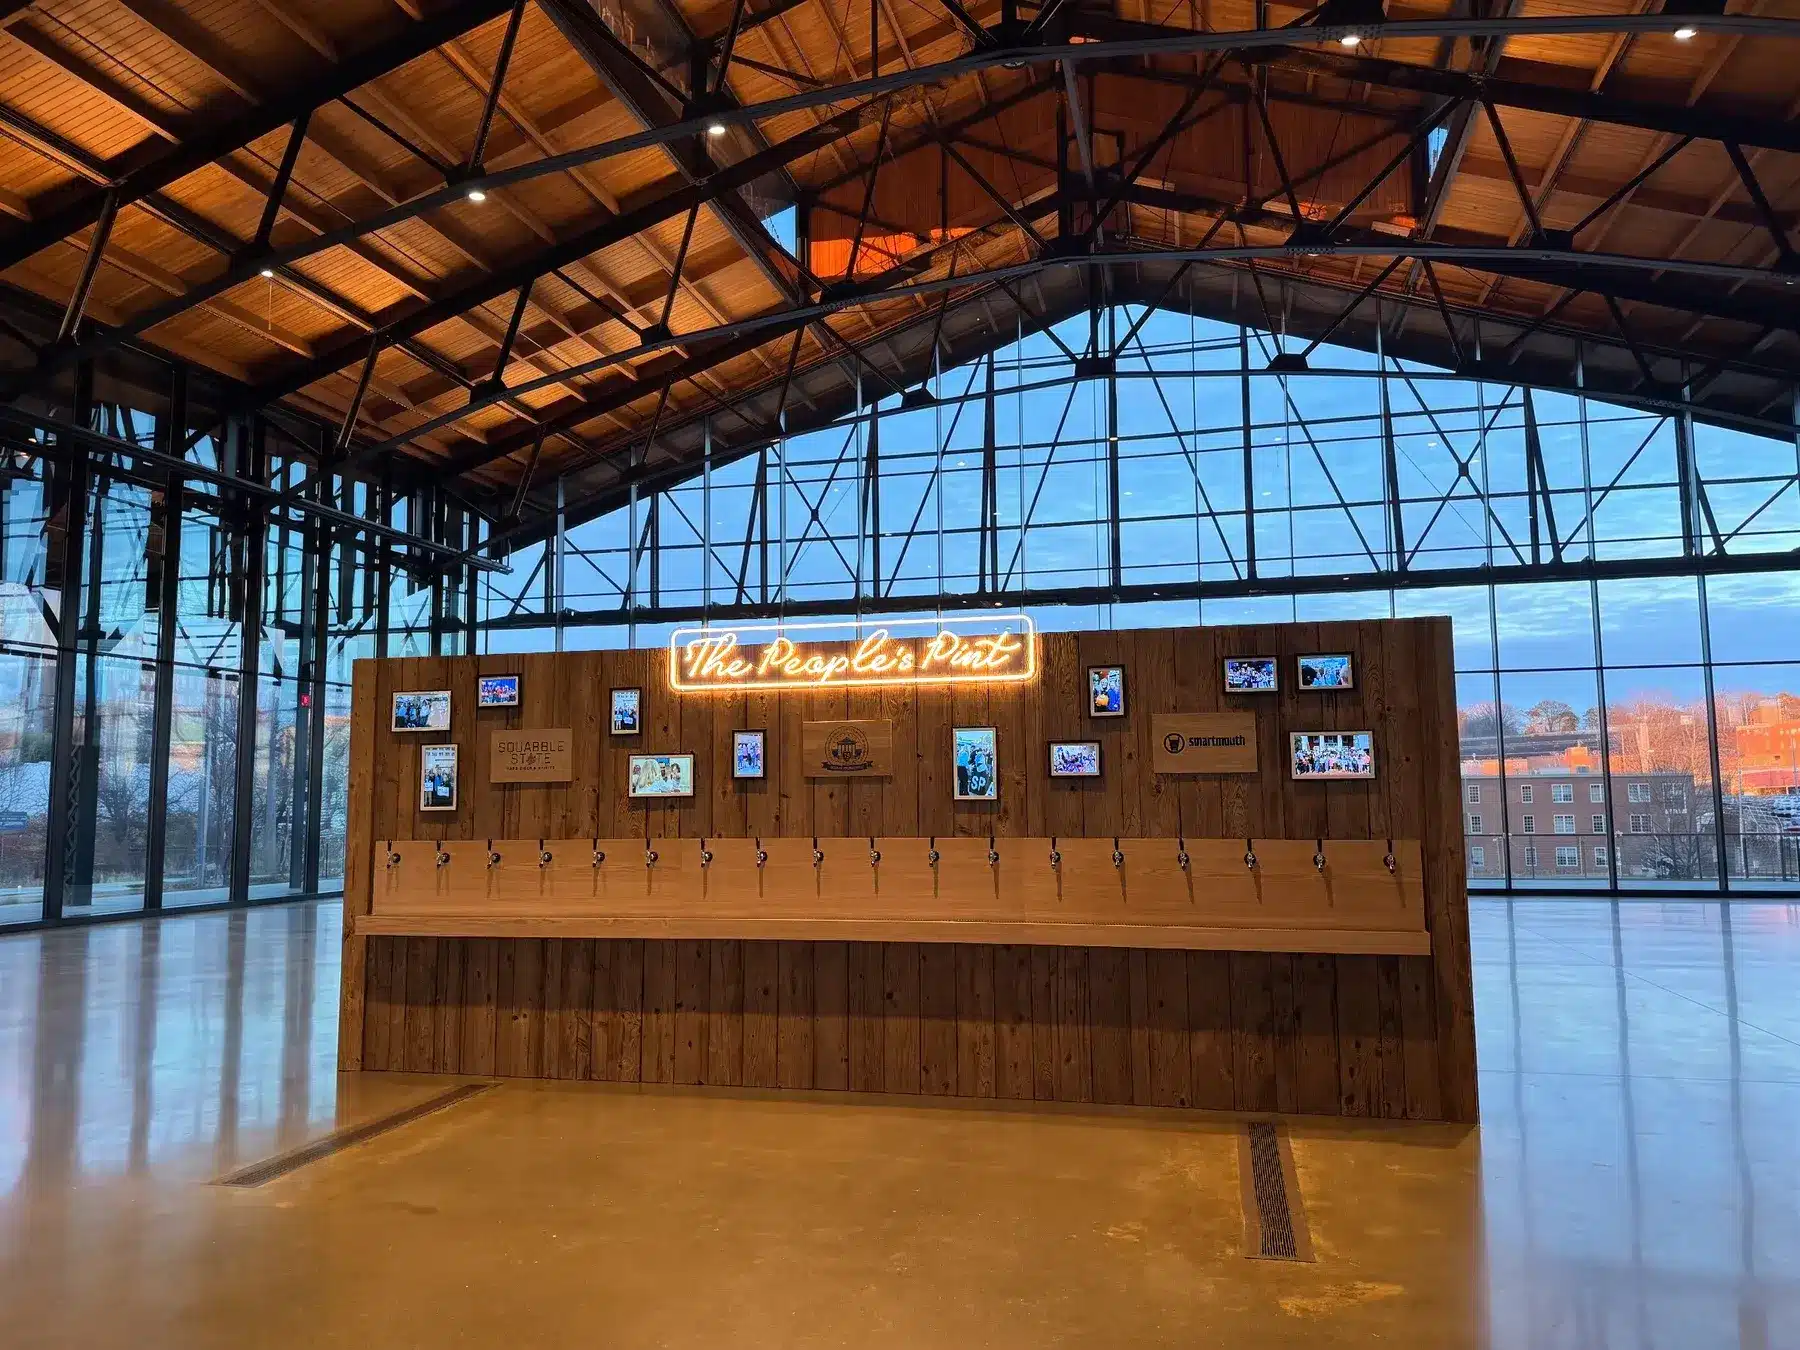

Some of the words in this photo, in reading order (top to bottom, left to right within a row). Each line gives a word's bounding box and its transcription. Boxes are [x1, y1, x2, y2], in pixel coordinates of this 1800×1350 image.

[684, 633, 752, 677] The
[757, 629, 914, 684] People's
[921, 630, 1022, 670] Pint
[498, 740, 564, 753] SQUABBLE
[1188, 735, 1246, 747] smartmouth
